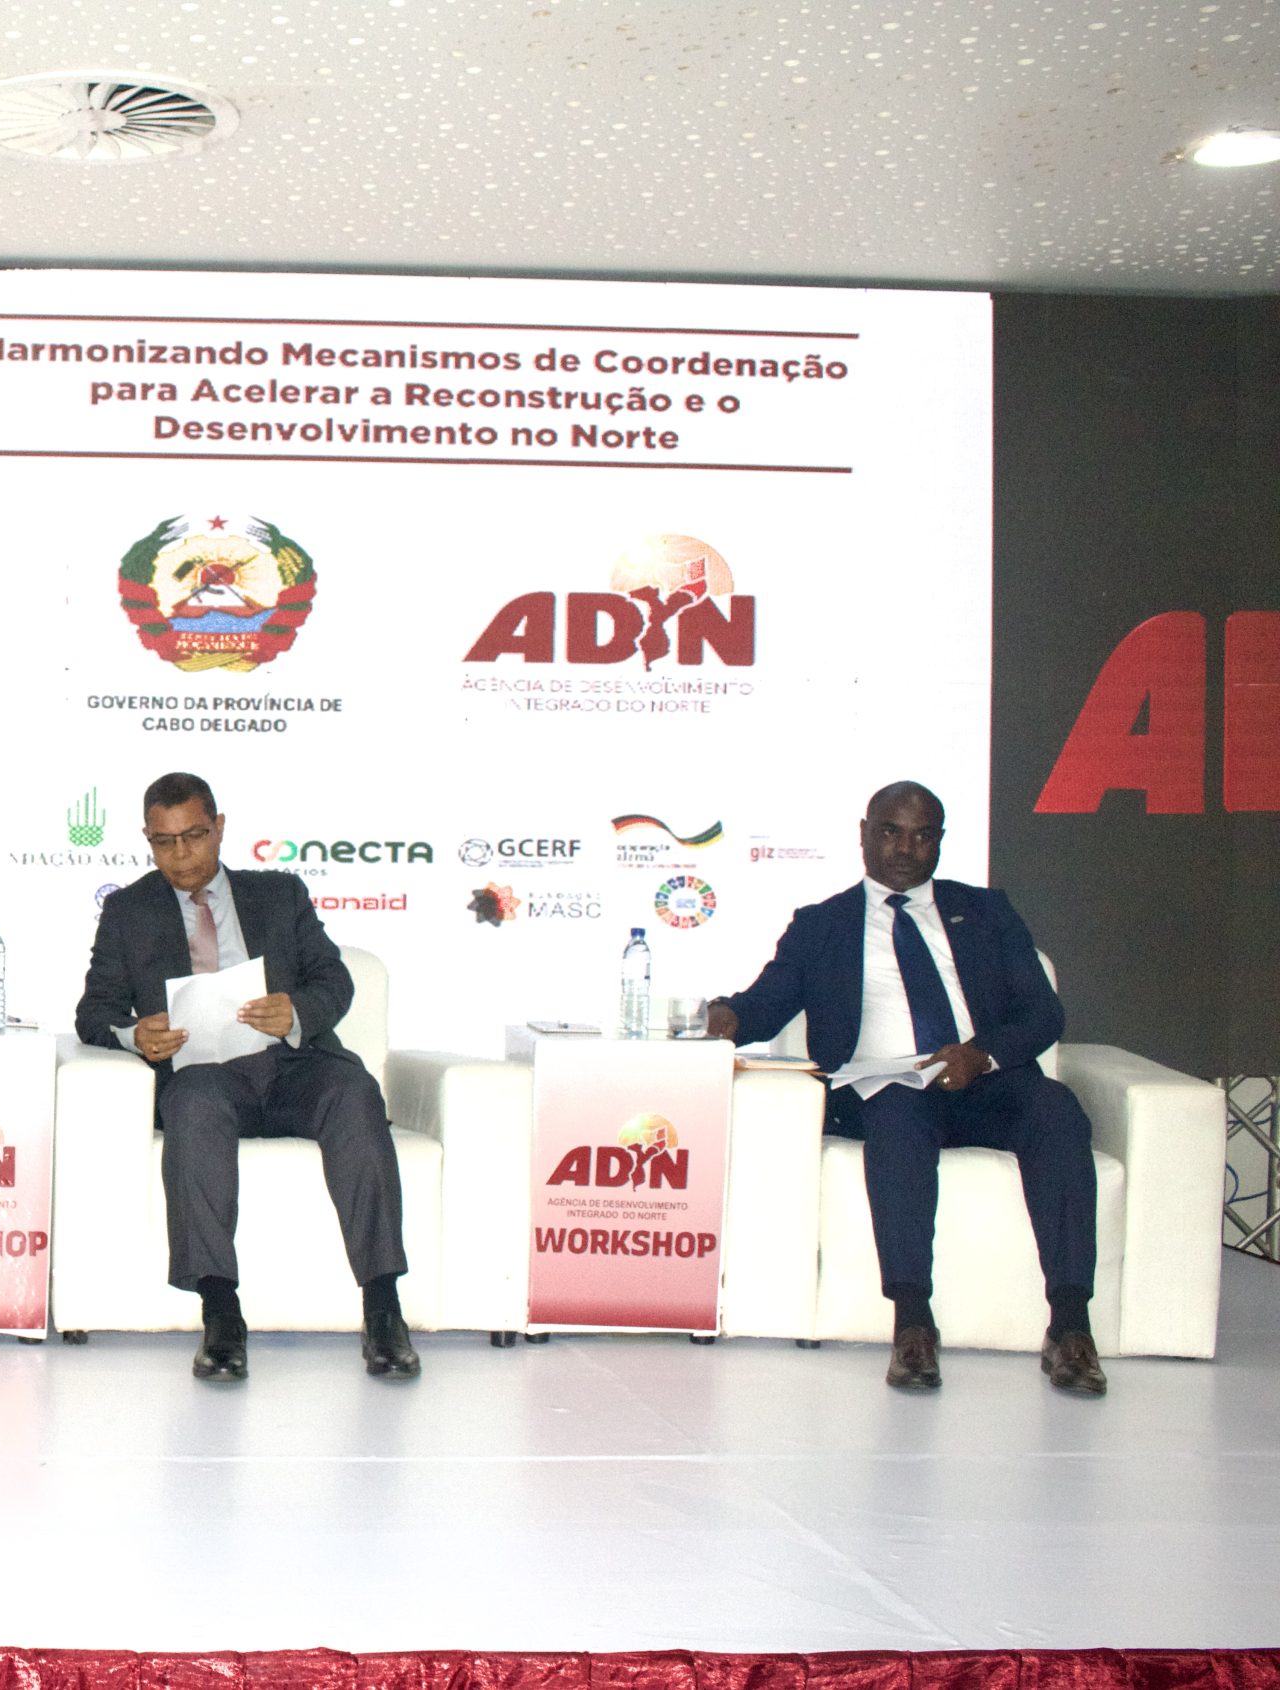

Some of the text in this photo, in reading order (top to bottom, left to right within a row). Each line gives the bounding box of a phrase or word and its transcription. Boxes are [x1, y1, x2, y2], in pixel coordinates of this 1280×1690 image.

[282, 343, 521, 370] Mecanismos
[534, 347, 580, 372] de
[594, 350, 848, 382] Coordenação
[91, 379, 740, 415] para Acelerar a Reconstrução e o
[153, 416, 679, 449] Desenvolvimento no Norte
[87, 693, 342, 711] GOVERNO DA PROVÍNCIA DE
[143, 717, 287, 732] CABO DELGADO
[498, 838, 581, 857] GCERF
[750, 846, 775, 862] giz
[528, 902, 602, 919] MASC
[547, 1197, 688, 1210] AGÊNCIA DE DESENVOLVIMENTO
[567, 1210, 668, 1221] INTEGRADO DO NORTE
[535, 1227, 717, 1258] WORKSHOP
